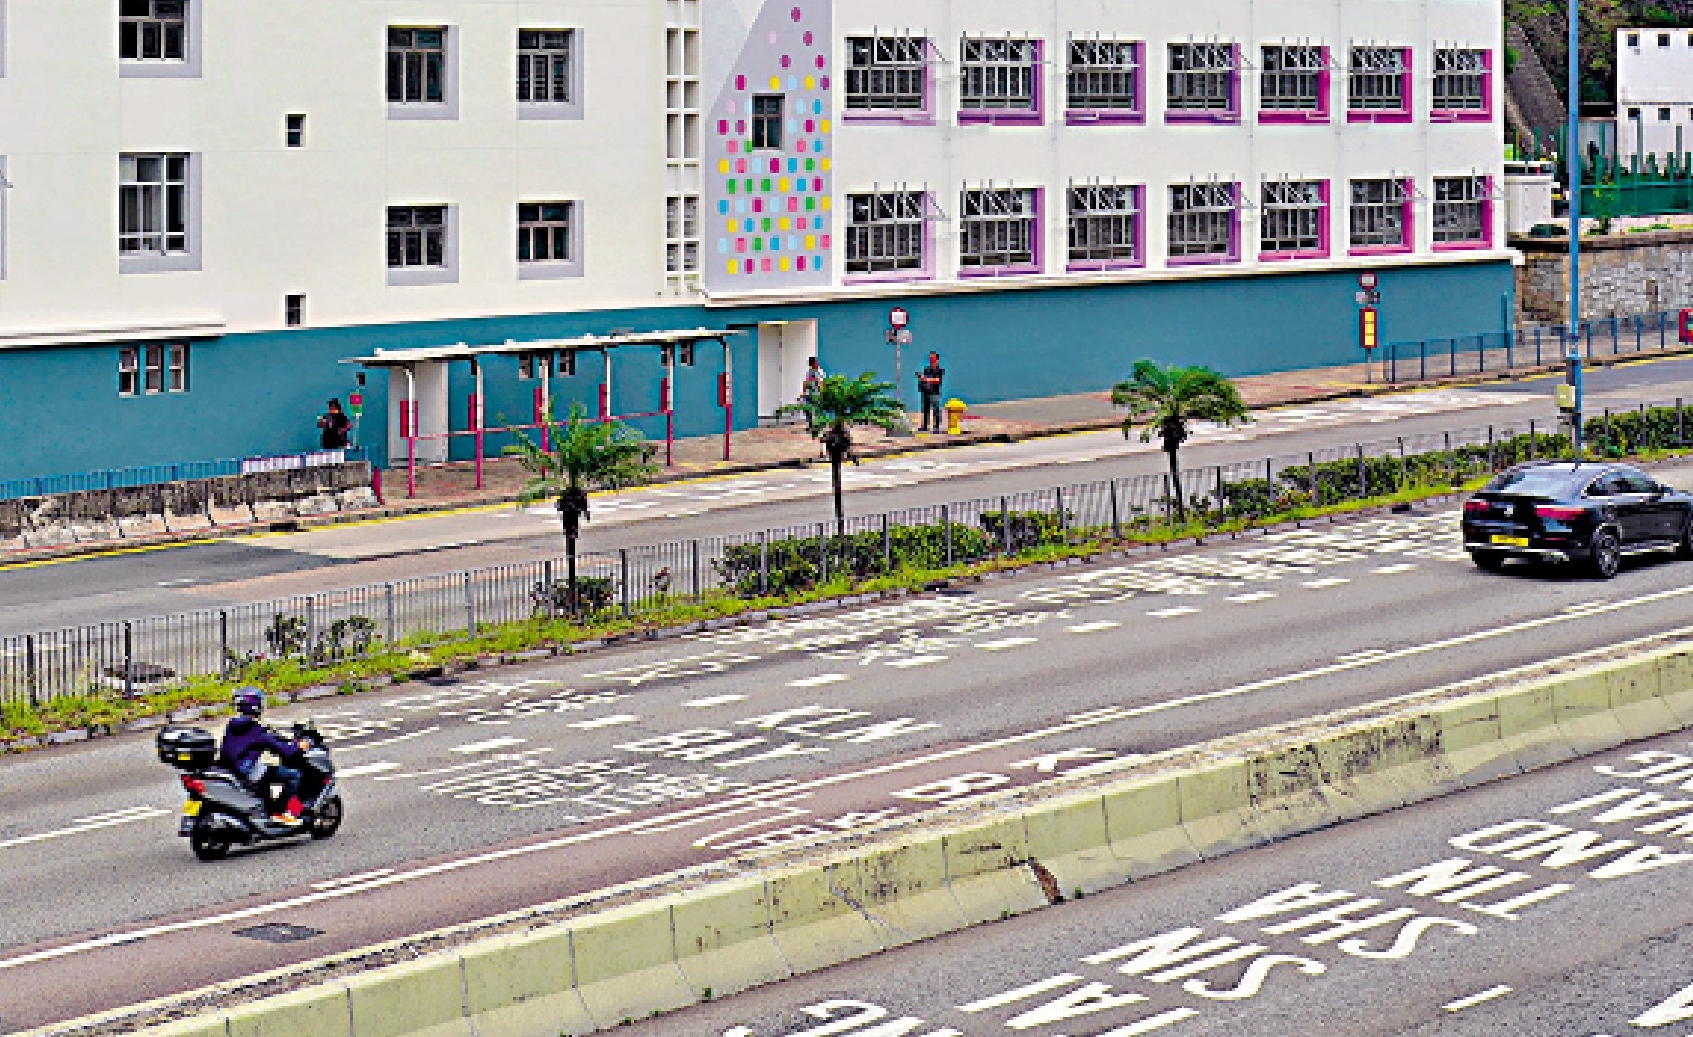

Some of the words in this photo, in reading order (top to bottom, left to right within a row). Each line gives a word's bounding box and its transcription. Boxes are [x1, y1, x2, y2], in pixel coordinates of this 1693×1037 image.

[612, 729, 830, 768] BAY
[734, 704, 942, 744] KLN
[1447, 820, 1693, 880] AND
[1370, 857, 1576, 921] TIN
[1213, 881, 1479, 960] SHA
[1079, 926, 1328, 1001] SIN
